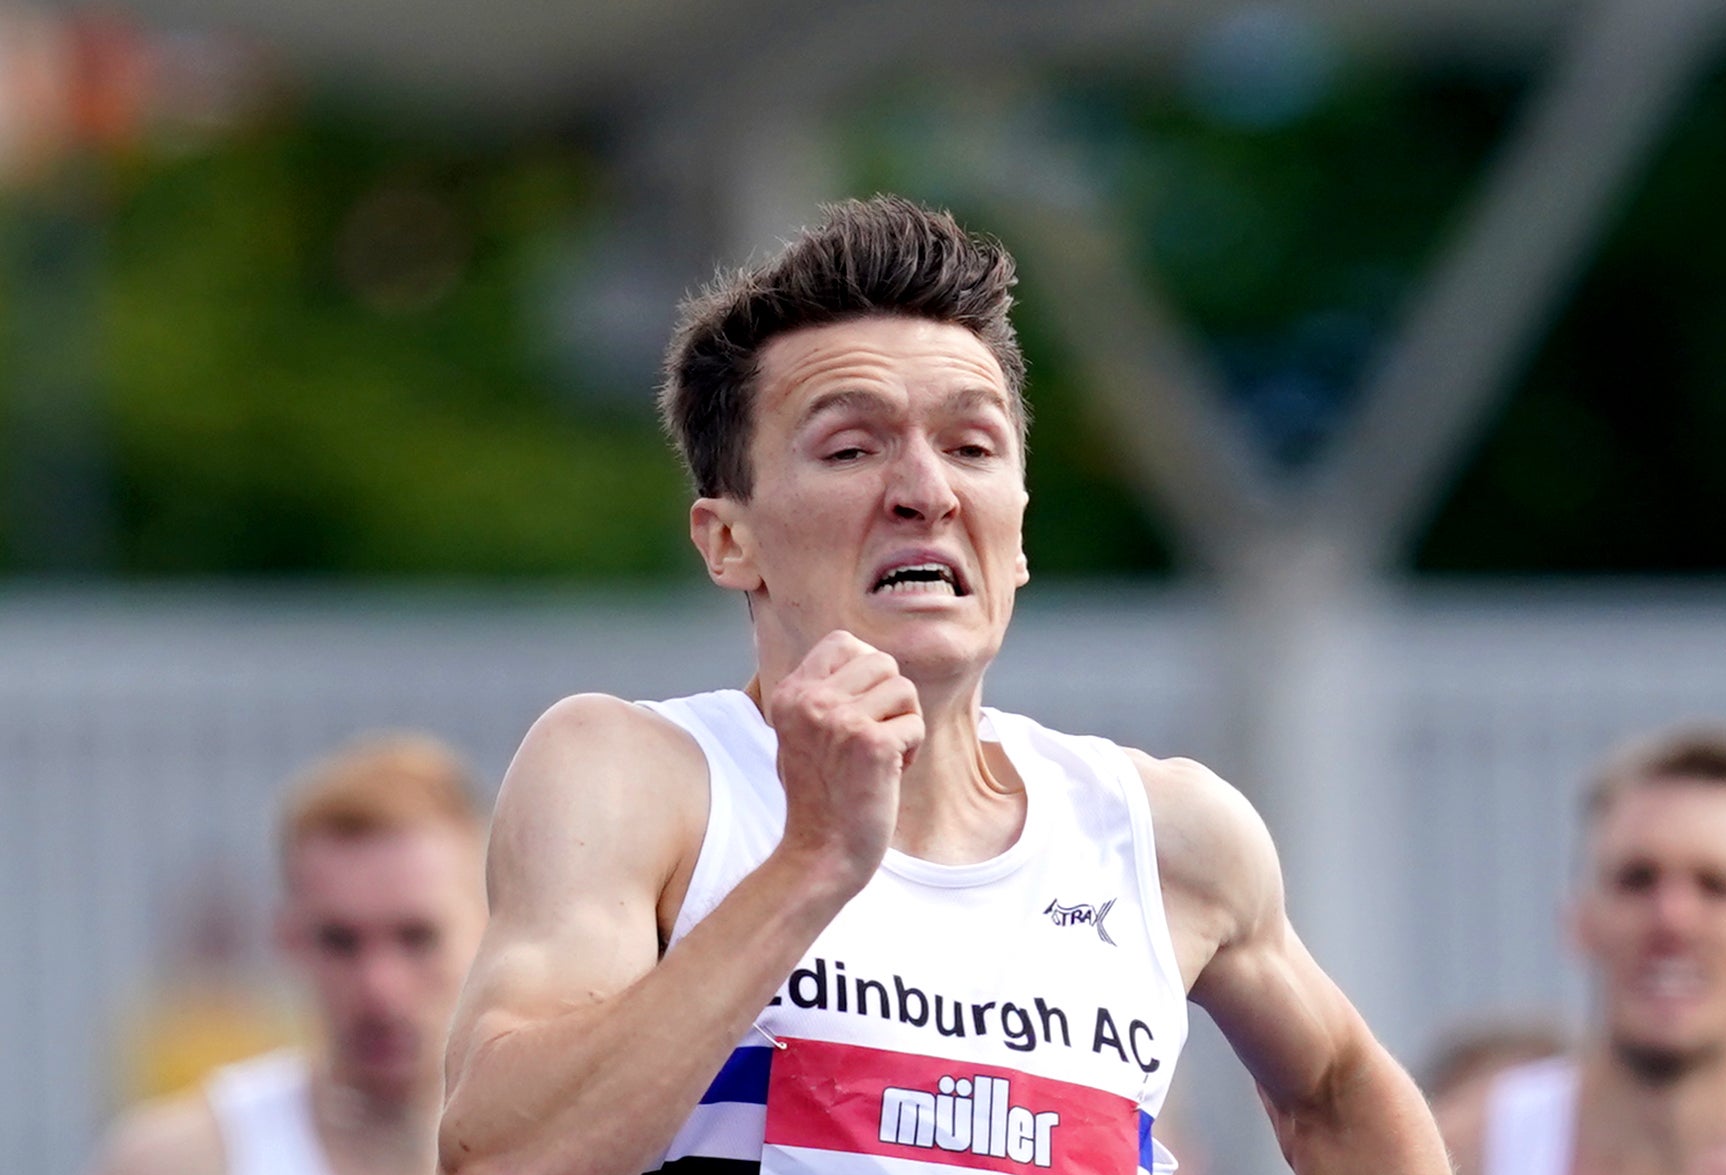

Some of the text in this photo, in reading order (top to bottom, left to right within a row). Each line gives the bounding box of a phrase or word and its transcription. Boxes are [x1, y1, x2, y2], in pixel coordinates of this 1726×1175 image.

[768, 958, 1160, 1074] dinburgh AC
[878, 1074, 1060, 1169] müller
